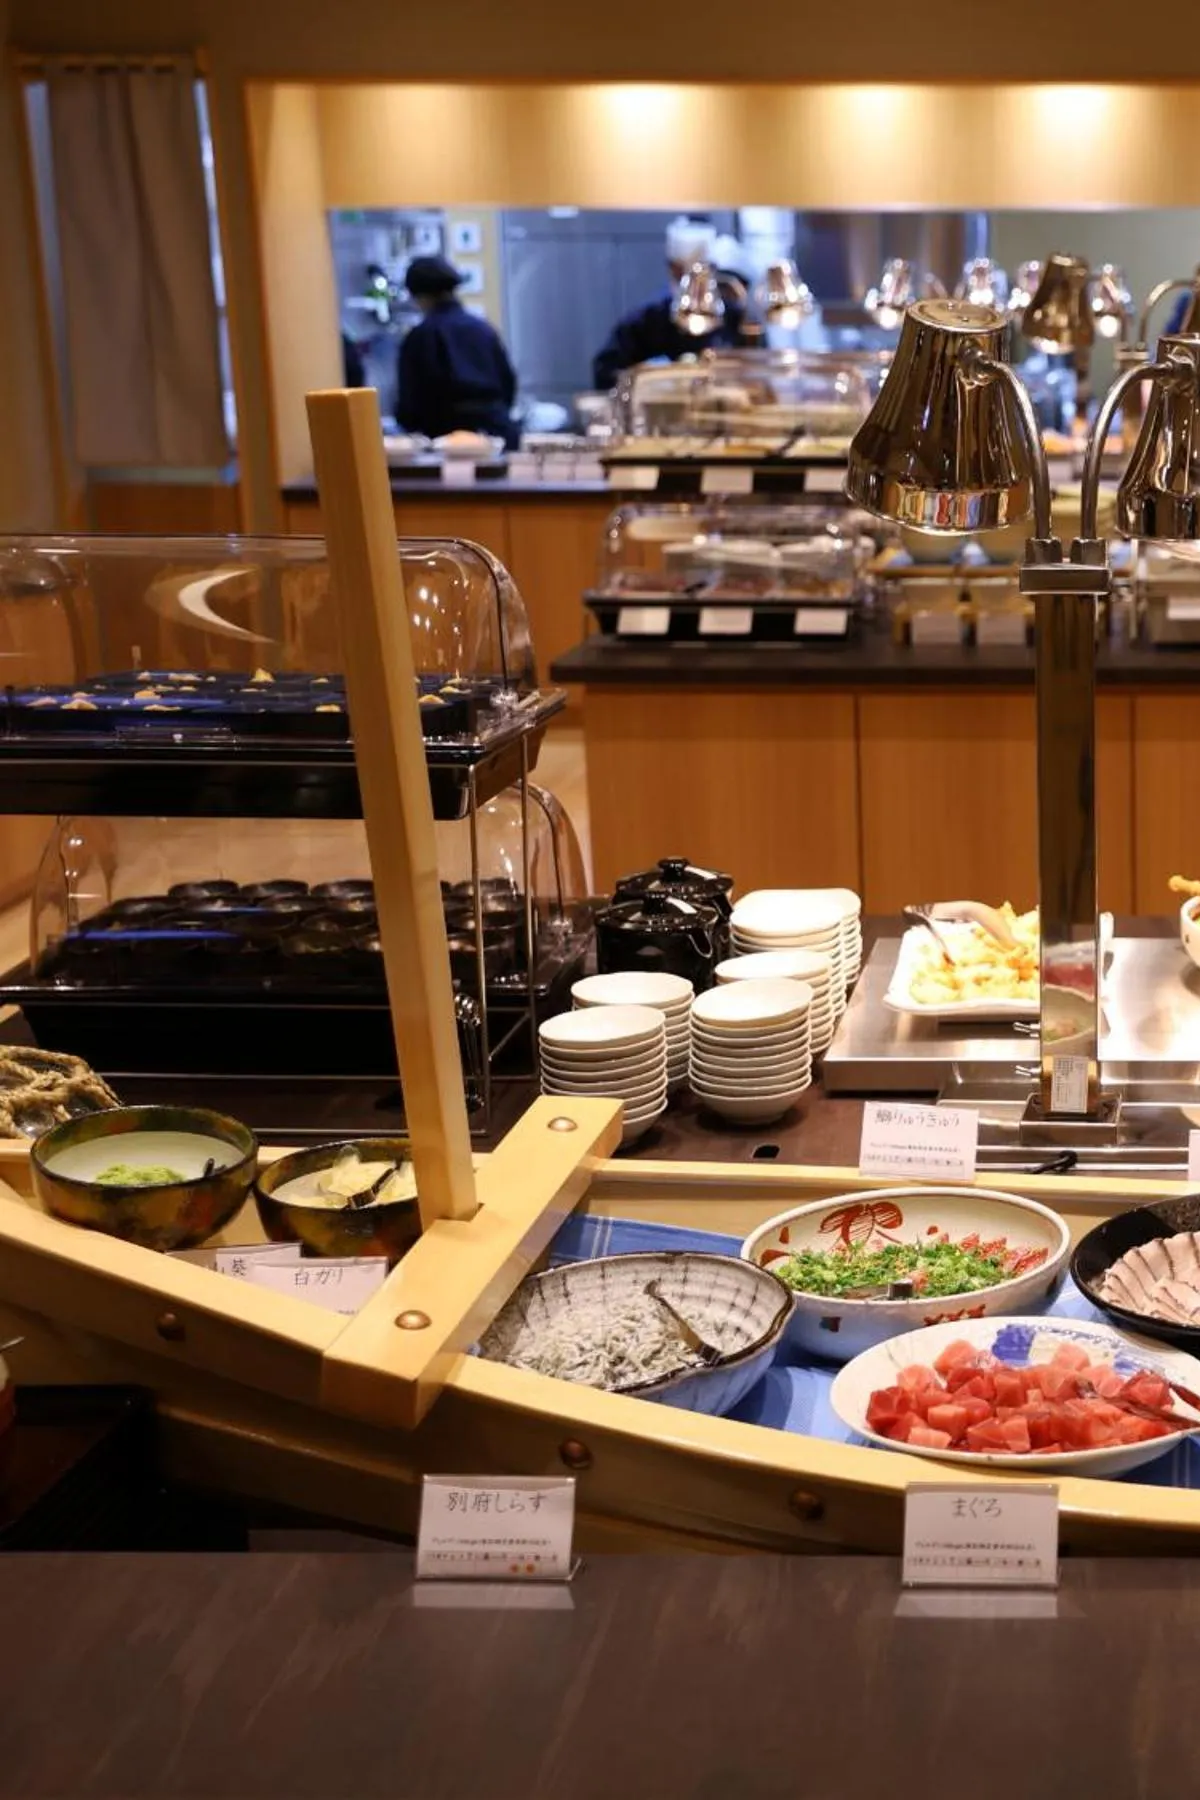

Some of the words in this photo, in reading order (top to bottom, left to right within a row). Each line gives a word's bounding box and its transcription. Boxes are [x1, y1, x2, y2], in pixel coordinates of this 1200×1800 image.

[446, 1491, 548, 1514] 別府しらす
[951, 1496, 1002, 1519] まぐろ
